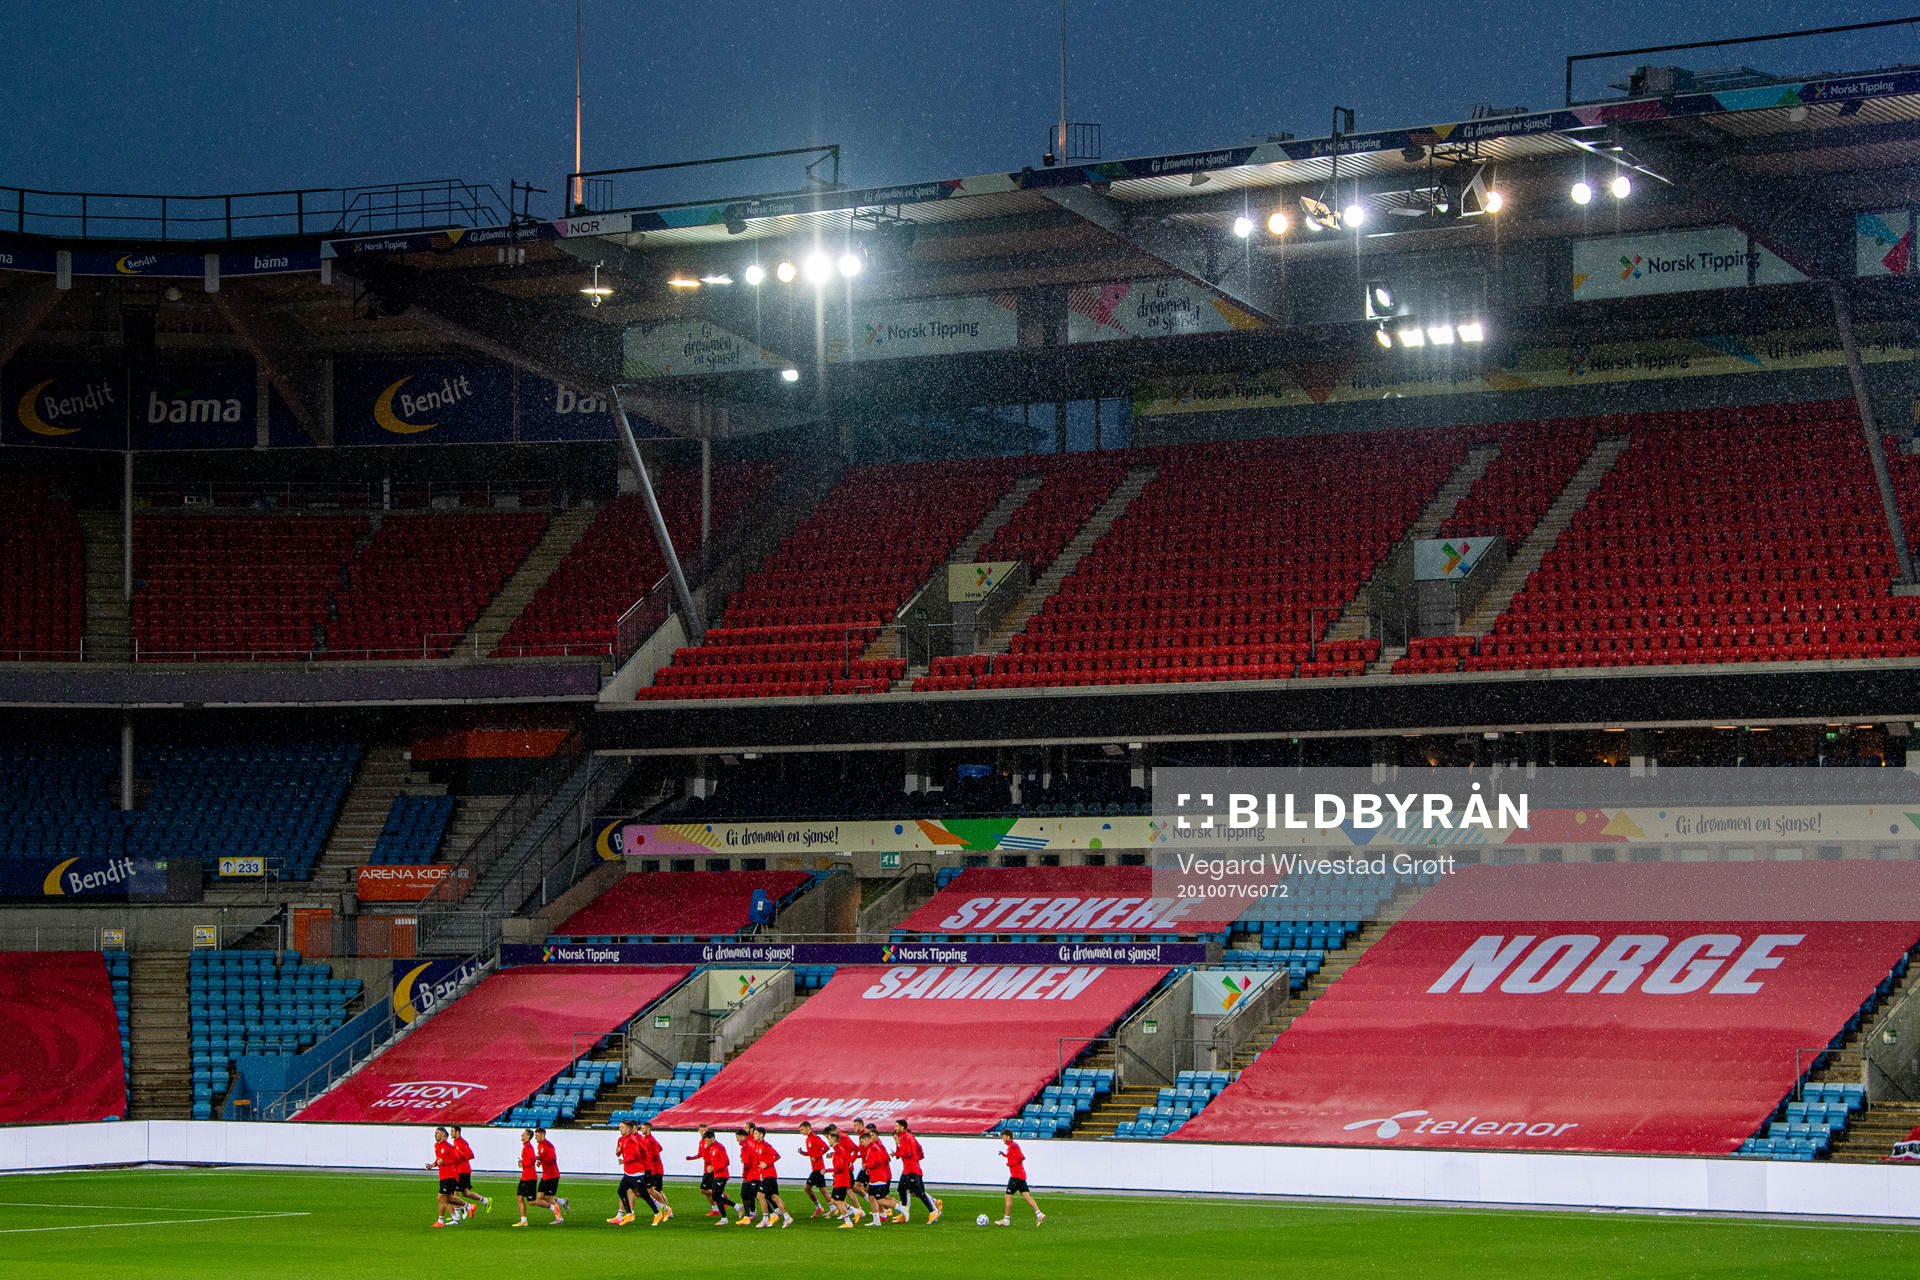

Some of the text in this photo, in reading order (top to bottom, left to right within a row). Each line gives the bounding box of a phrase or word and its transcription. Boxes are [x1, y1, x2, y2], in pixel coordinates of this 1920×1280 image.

[1830, 80, 1895, 96] Norsk Tipping
[1464, 125, 1473, 139] Gi
[1523, 115, 1552, 134] sjanse!
[1325, 138, 1380, 153] Nrsk Tipping
[1206, 150, 1232, 169] sjanse!
[127, 254, 158, 269] Bendit
[254, 255, 289, 269] bama
[1648, 254, 1695, 274] Norsk
[888, 319, 979, 340] Norsk Tipping
[44, 379, 115, 419] Bendit
[147, 391, 242, 423] bama
[401, 375, 473, 418] Bendit
[1172, 823, 1265, 842] Norsk Tipping
[1676, 812, 1822, 836] Gi drømmen en sjanse!
[726, 826, 839, 848] Gi drømmen en sjanse!
[68, 857, 136, 893] Bendit
[238, 863, 259, 873] 233
[360, 869, 414, 879] ARENA
[940, 897, 1203, 929] STERKERE
[558, 949, 586, 960] Norsk
[587, 948, 620, 962] Tipping
[702, 946, 713, 961] Gi
[752, 949, 764, 959] en
[765, 945, 795, 961] sjanse!
[899, 948, 928, 960] Norsk
[930, 947, 968, 962] Tipping
[1059, 946, 1071, 961] Gi
[1072, 944, 1113, 961] drømmen
[1114, 948, 1126, 959] en
[1127, 944, 1161, 962] sjanse!
[1426, 934, 1807, 994] NORGE
[862, 966, 1107, 1000] SAMMEN
[387, 1081, 488, 1099] THON
[371, 1099, 452, 1109] HOTELS
[762, 1097, 870, 1119] KIWI
[1413, 1115, 1580, 1138] telenor
